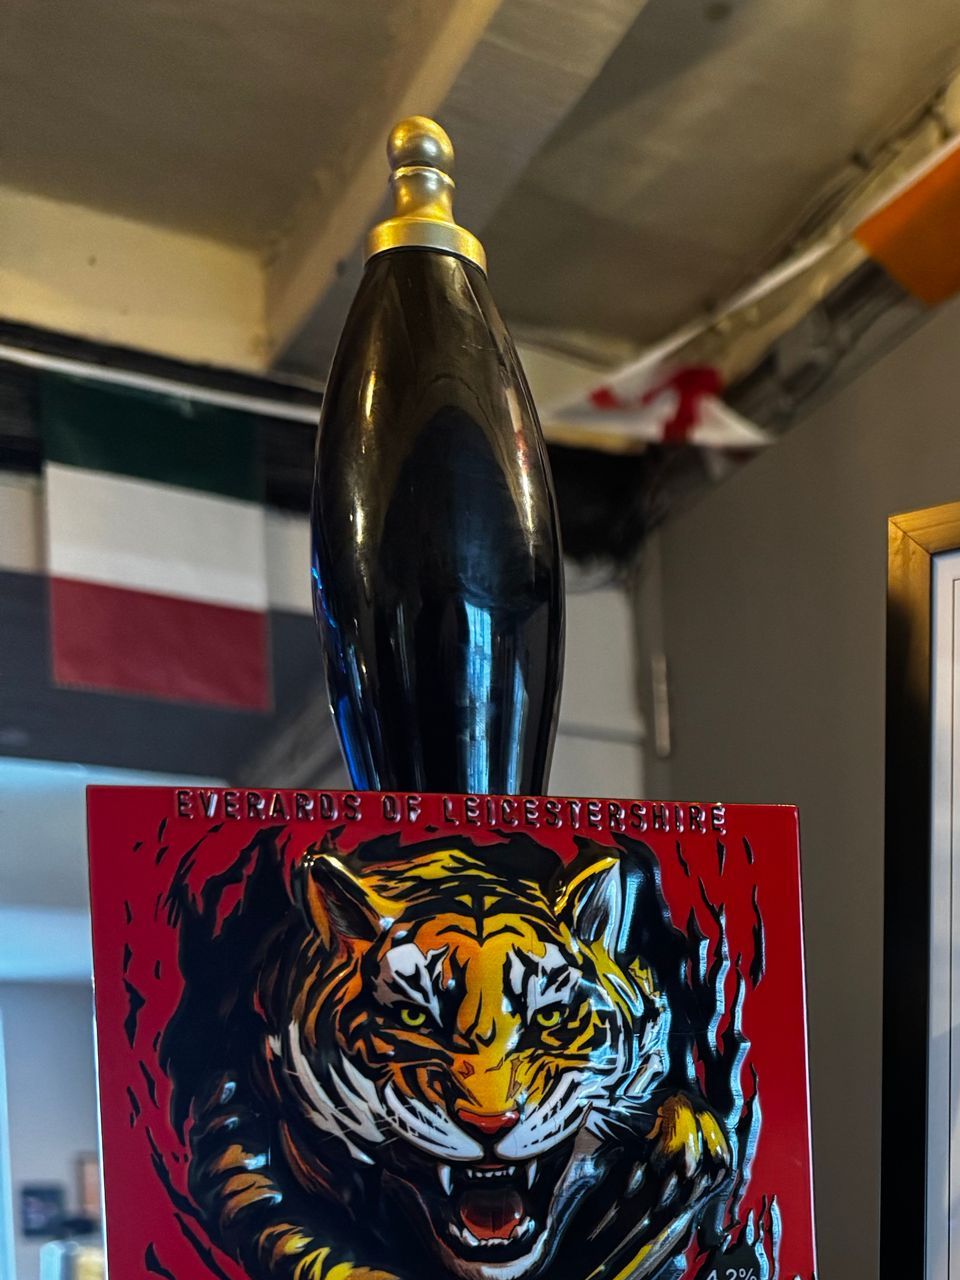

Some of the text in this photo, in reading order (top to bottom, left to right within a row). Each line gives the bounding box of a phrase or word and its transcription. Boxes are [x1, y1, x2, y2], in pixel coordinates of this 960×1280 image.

[176, 790, 726, 835] EVERARDS OF LEICESTERSHIRE
